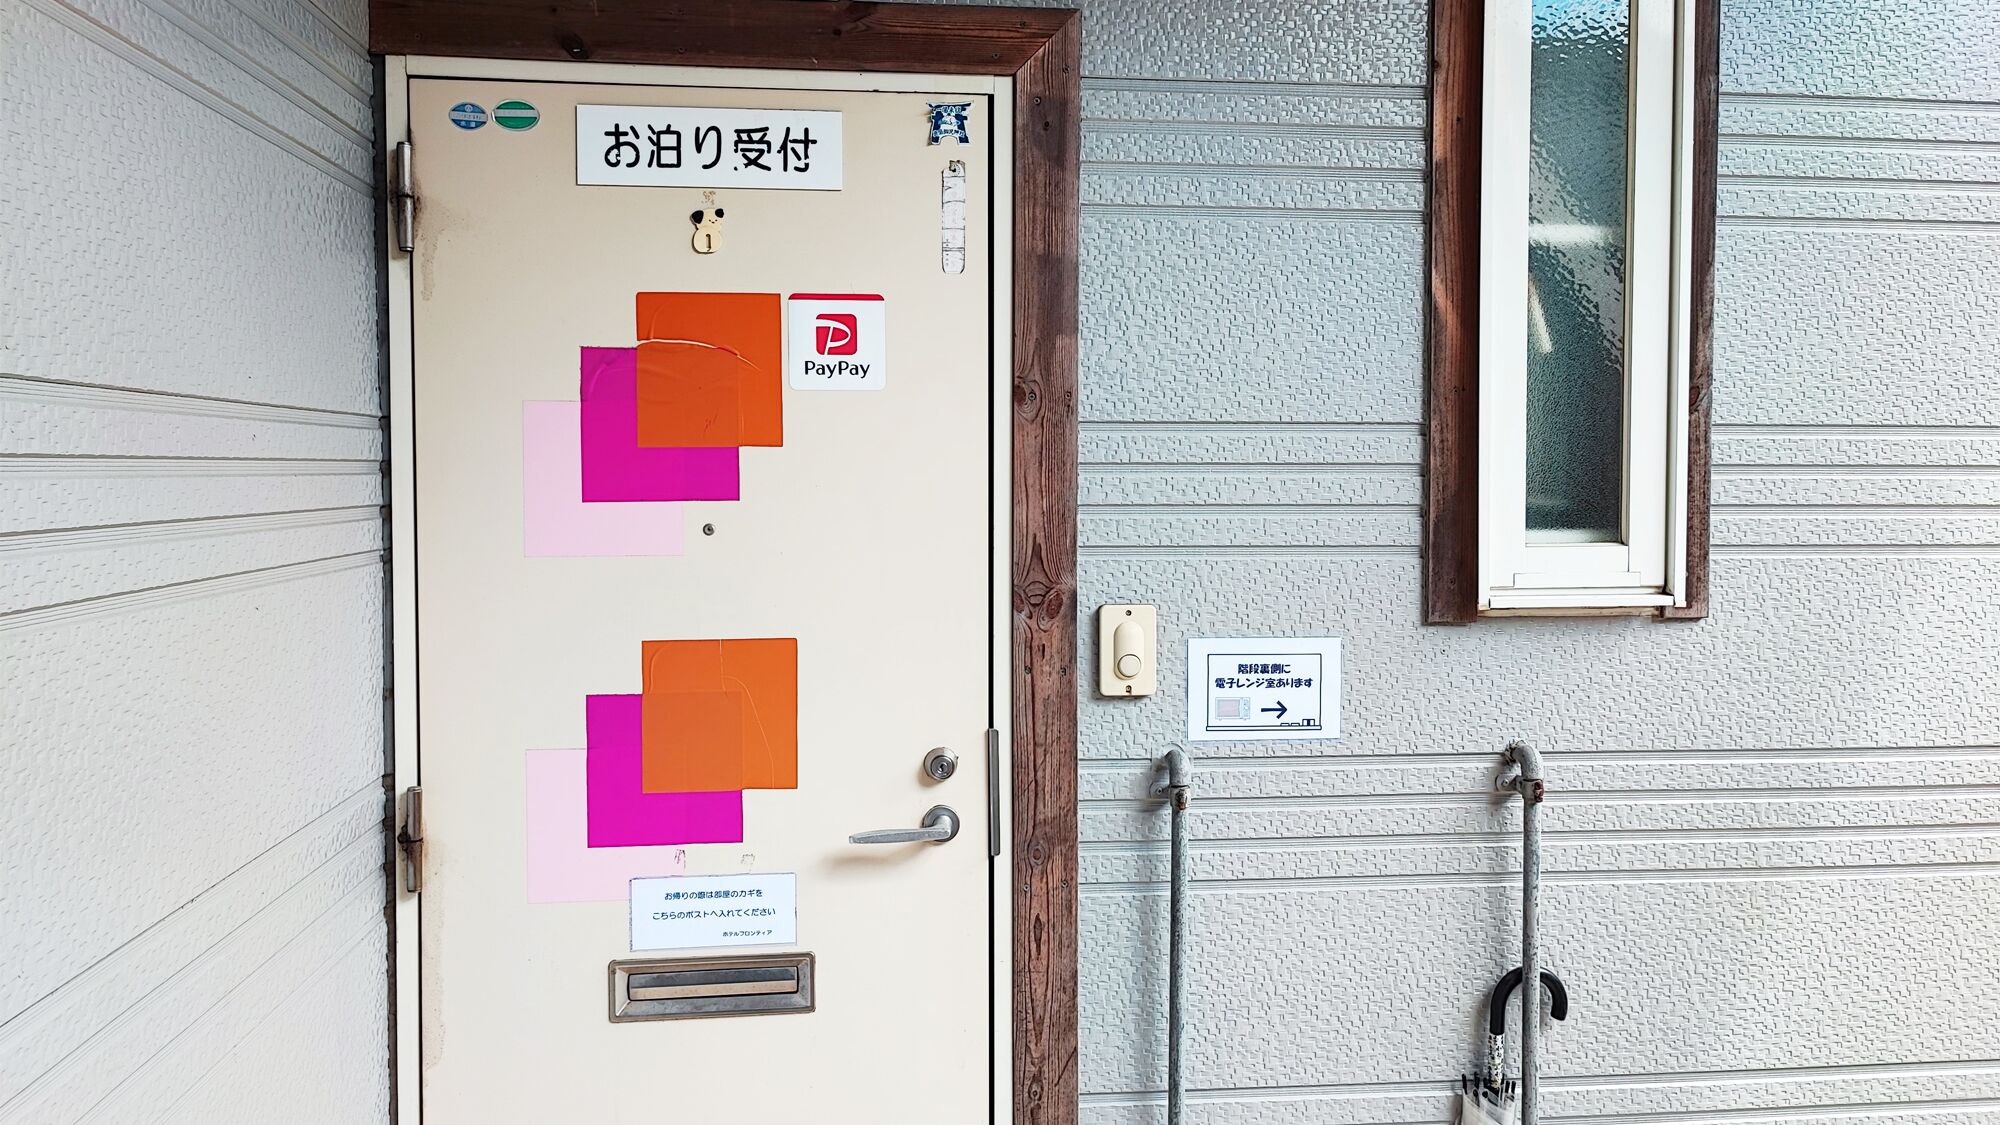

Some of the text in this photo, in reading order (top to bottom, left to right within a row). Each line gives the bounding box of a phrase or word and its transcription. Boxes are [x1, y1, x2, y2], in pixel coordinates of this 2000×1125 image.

[604, 123, 818, 173] お泊り受付
[804, 360, 871, 379] PayPay
[1237, 663, 1291, 675] 階段裏側に
[1215, 677, 1314, 689] 電子レンジ室あります
[652, 907, 776, 921] こちらのポストへ入れてください
[722, 929, 773, 937] ホテルフロンティア
